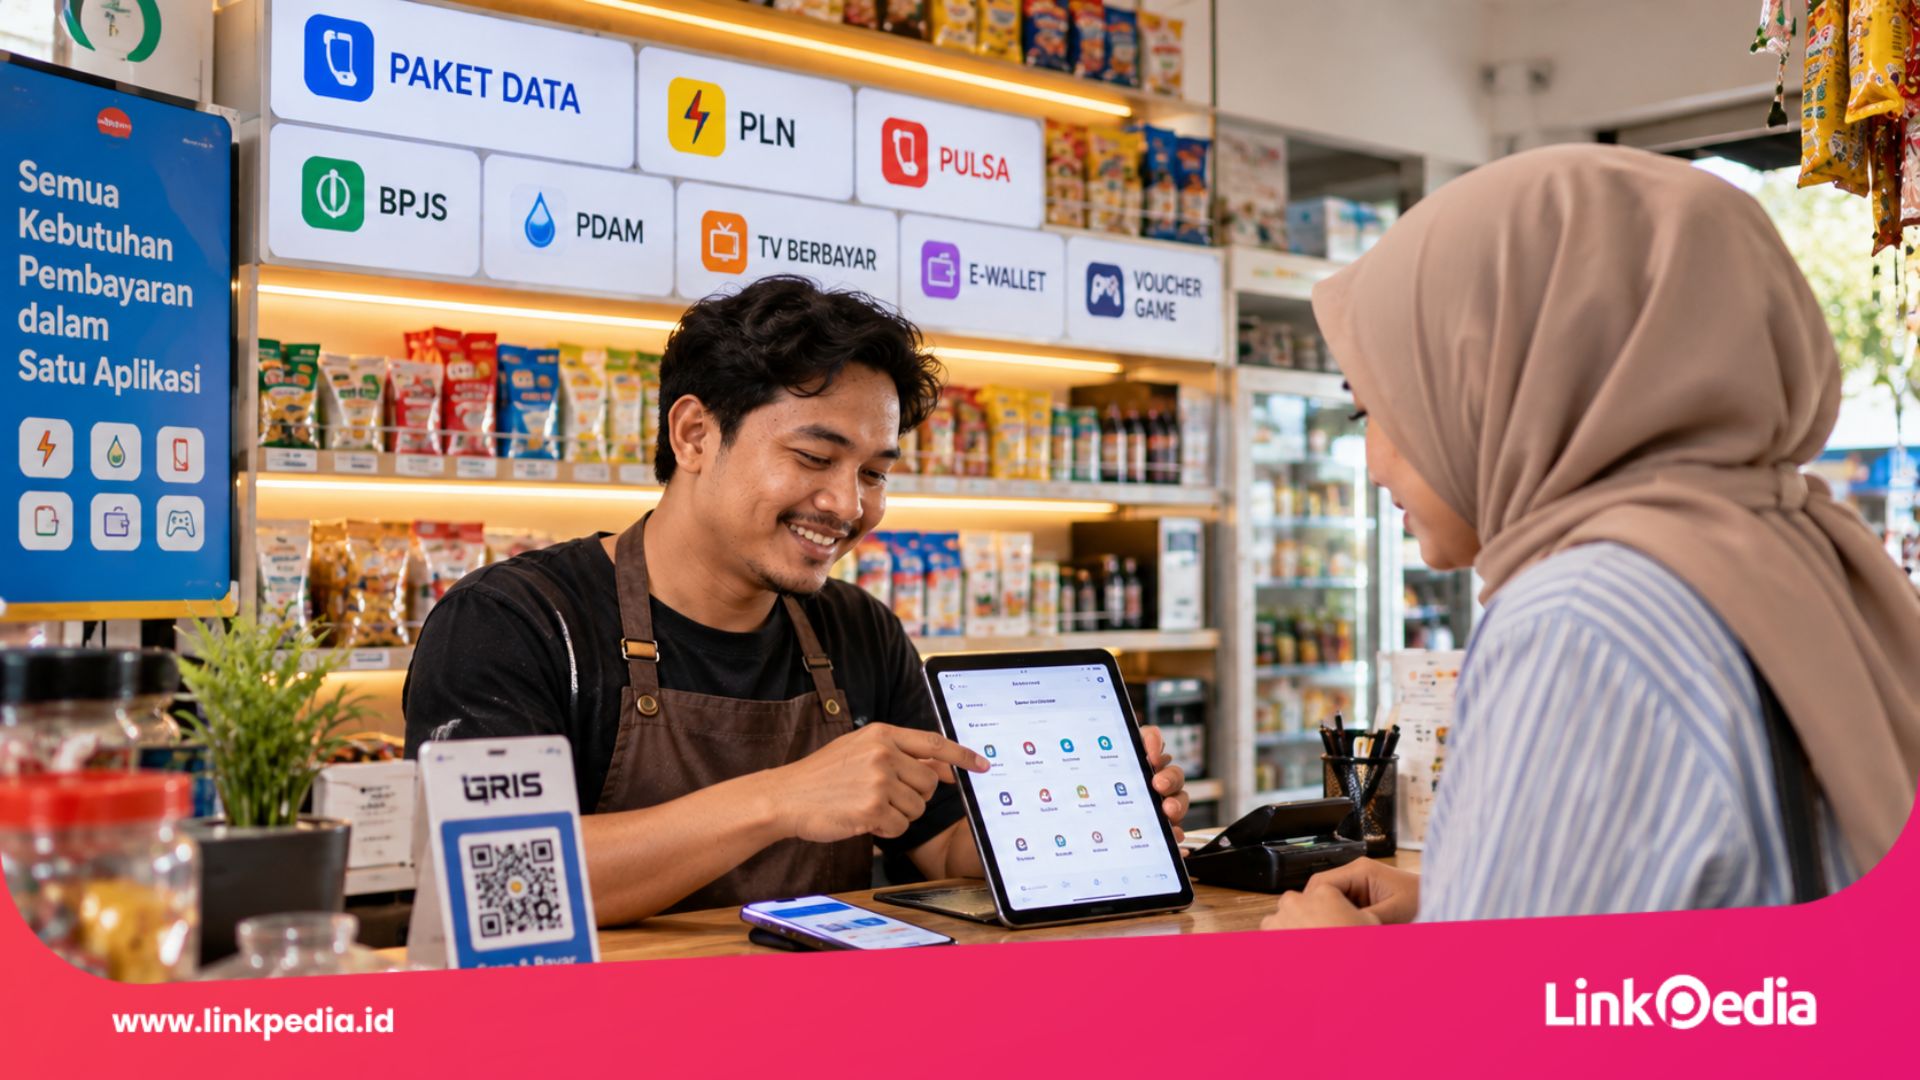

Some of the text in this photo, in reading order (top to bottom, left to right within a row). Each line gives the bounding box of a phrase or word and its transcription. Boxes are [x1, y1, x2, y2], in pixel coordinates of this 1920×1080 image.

[390, 51, 581, 115] PAKET DATA
[740, 110, 795, 149] PLN
[939, 146, 1011, 183] PULSA
[18, 159, 120, 209] Semua
[379, 186, 448, 222] BPJS
[18, 208, 173, 262] Kebutuhan
[576, 211, 644, 245] PDAM
[757, 235, 877, 272] TV BERBAYAR
[18, 255, 193, 308] Pembayaran
[969, 262, 1047, 292] E-WALLET
[1133, 270, 1202, 298] VOUCHER
[18, 303, 109, 343] dalam
[1134, 297, 1177, 322] GAME
[18, 348, 201, 397] Satu Aplikasi
